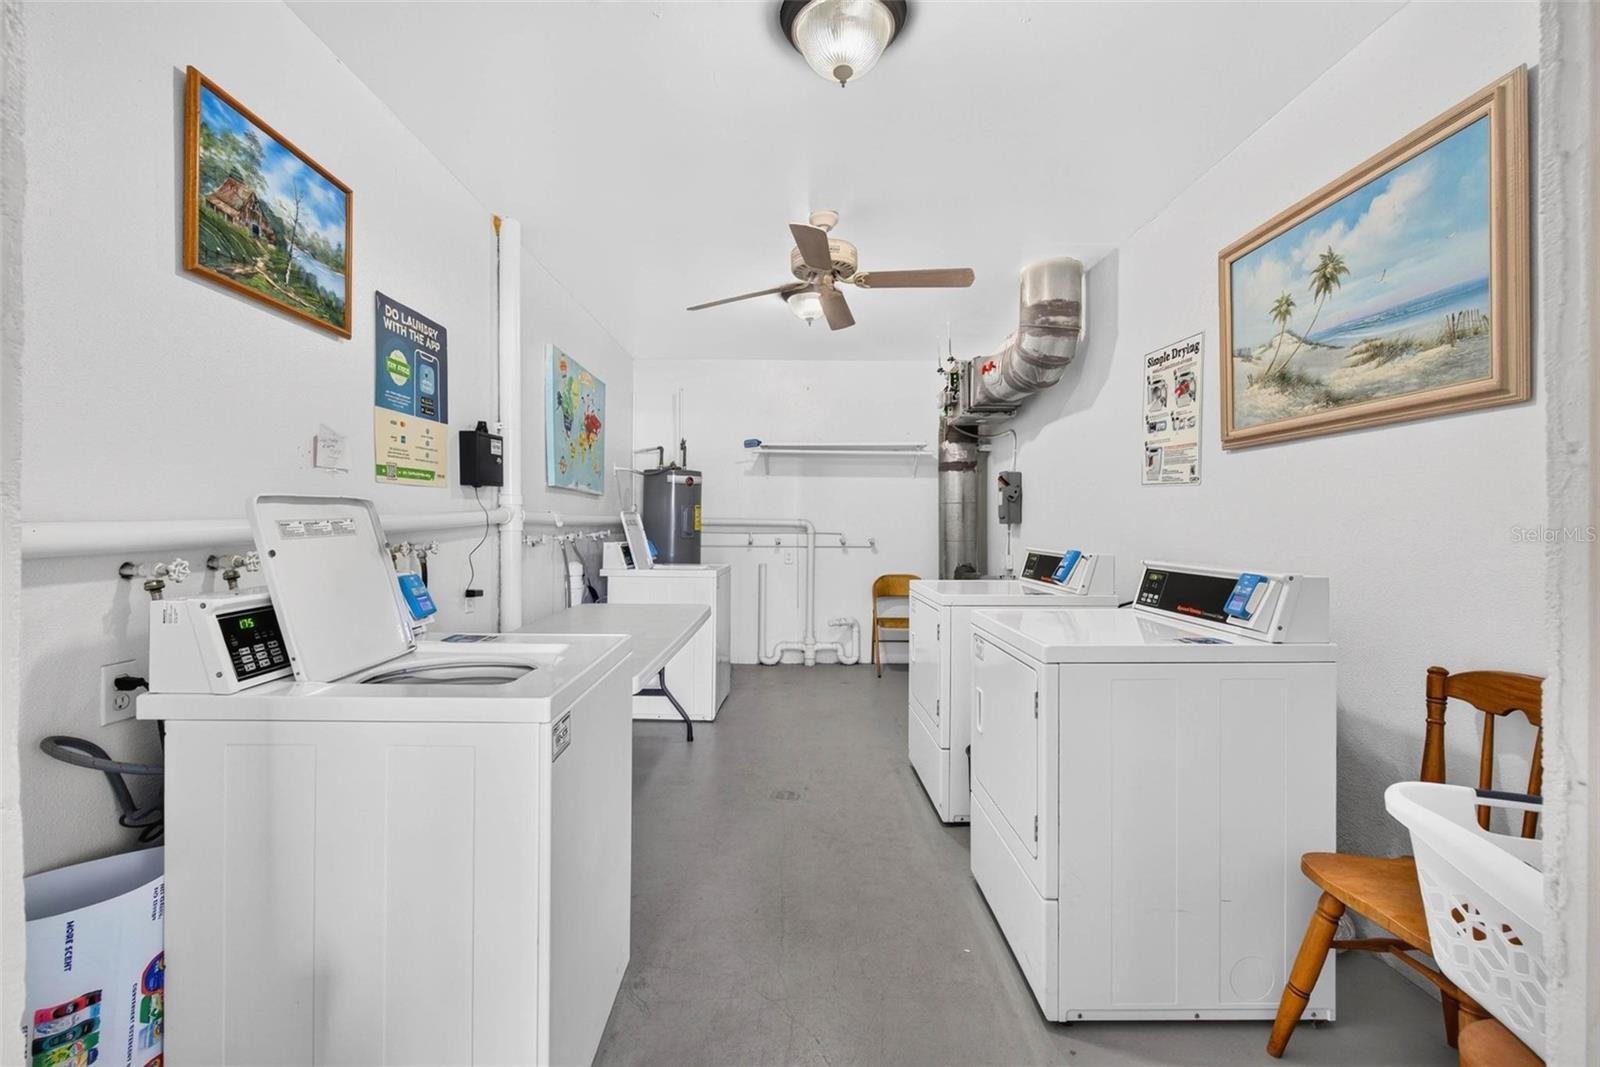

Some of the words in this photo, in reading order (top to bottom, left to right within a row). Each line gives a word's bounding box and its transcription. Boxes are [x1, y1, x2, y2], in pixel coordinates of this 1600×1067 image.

[383, 315, 407, 338] WITH
[408, 328, 425, 346] THE
[425, 337, 441, 352] APP
[384, 304, 399, 320] DO
[401, 312, 438, 340] LAUNDRY
[1147, 351, 1170, 368] Simple
[1171, 341, 1200, 360] Drying
[65, 920, 75, 945] MORE
[63, 945, 73, 973] SCENT
